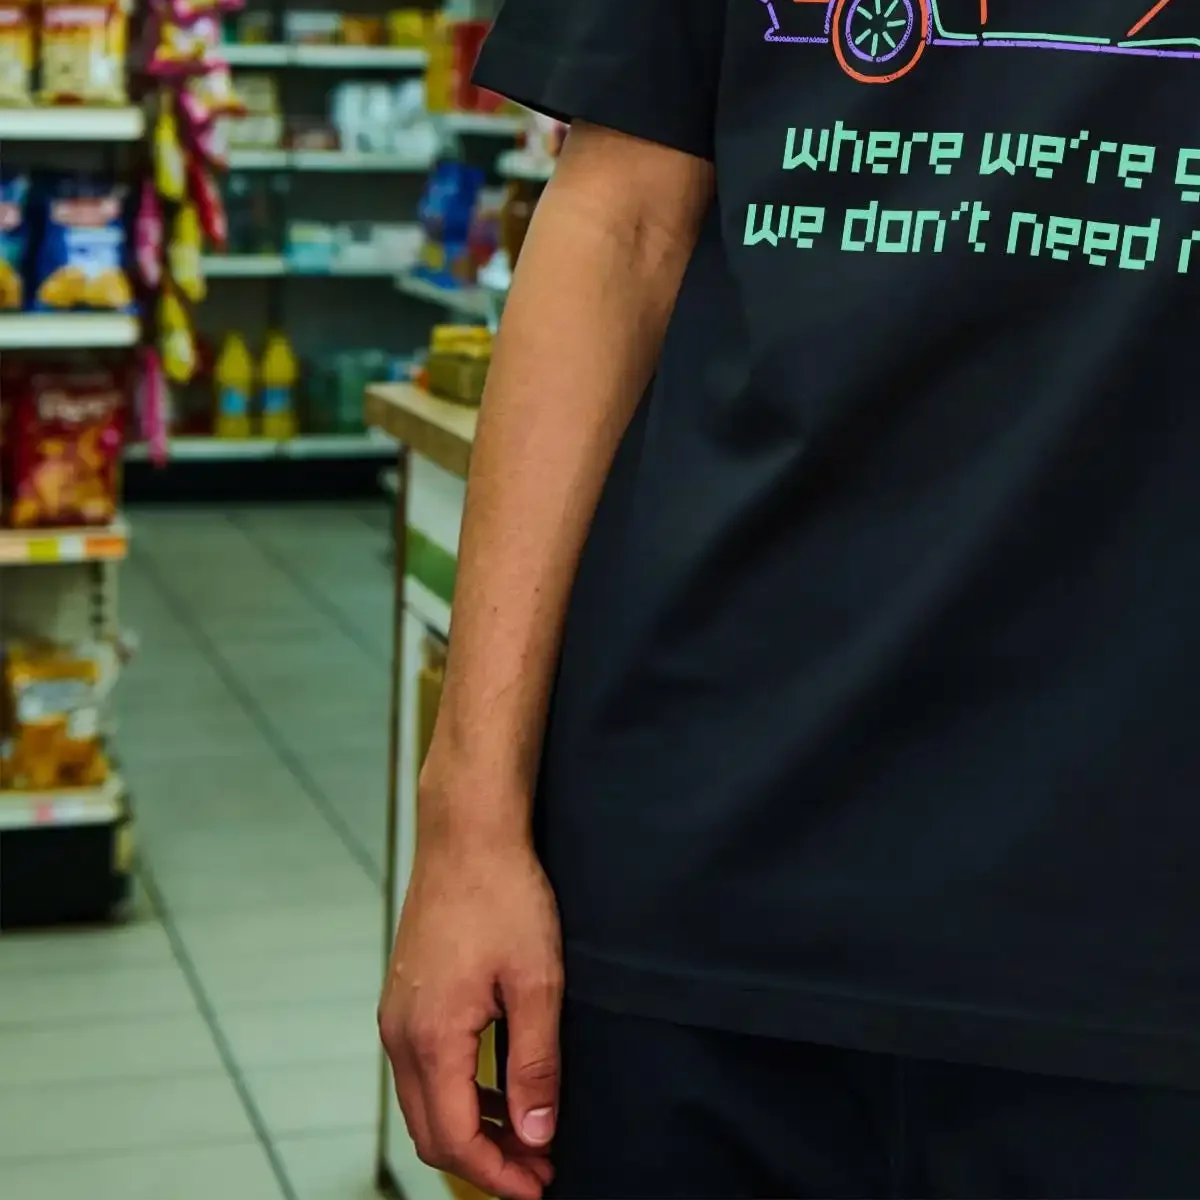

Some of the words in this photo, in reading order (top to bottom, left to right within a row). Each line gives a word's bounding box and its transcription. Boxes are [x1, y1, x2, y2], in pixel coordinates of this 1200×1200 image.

[783, 121, 965, 175] where
[978, 131, 1156, 189] we're
[743, 202, 826, 249] we
[840, 201, 991, 253] don't
[1006, 211, 1161, 271] need
